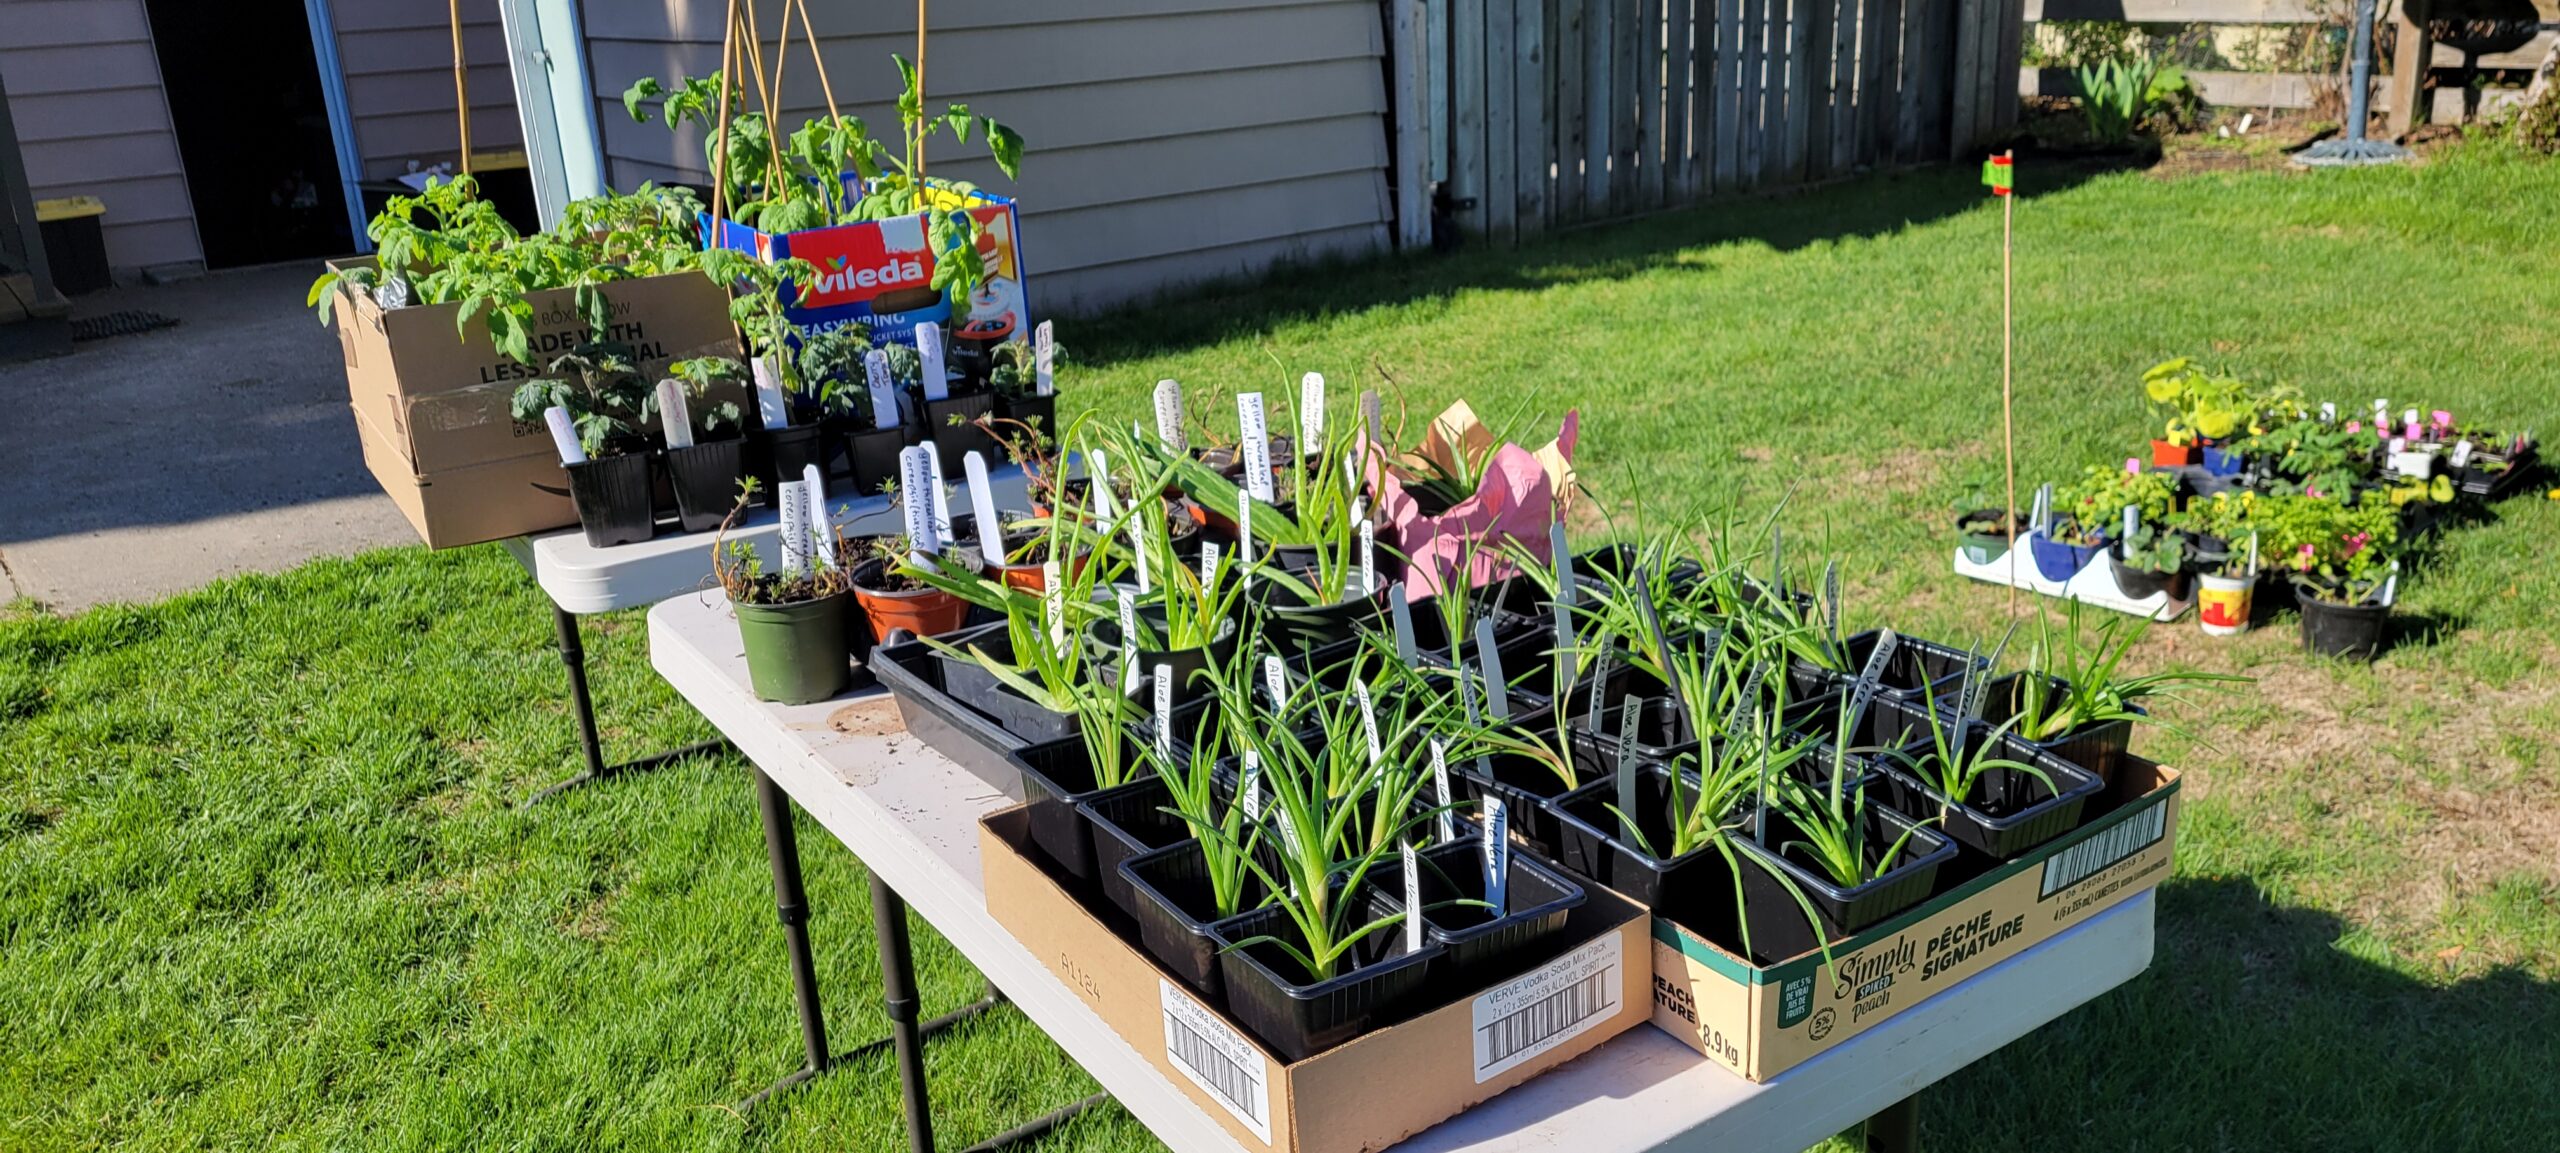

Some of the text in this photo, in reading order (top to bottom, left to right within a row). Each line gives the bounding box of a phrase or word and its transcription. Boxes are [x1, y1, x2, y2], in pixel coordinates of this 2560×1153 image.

[814, 258, 924, 294] vileda
[541, 310, 572, 326] BOX
[512, 331, 574, 354] ADE
[480, 361, 541, 384] LESS
[1248, 397, 1262, 430] yellow
[797, 485, 808, 518] yellow
[919, 452, 936, 534] yellow threadleaf
[1205, 547, 1216, 573] Aloe
[1158, 674, 1167, 703] Aloe
[1269, 663, 1280, 692] Aloe
[1594, 642, 1612, 711] Aloe Vera
[1855, 642, 1891, 705] Aloe Vera
[1463, 680, 1475, 710] Aloe
[1731, 670, 1764, 736] Aloe Vera
[1959, 687, 1973, 719] Vera
[1361, 691, 1376, 748] Aloe Vera
[1621, 703, 1638, 765] Aloe Vera
[1433, 750, 1443, 781] Aloe
[1245, 794, 1256, 816] Ver
[1488, 806, 1504, 870] Aloe Vera
[1405, 848, 1416, 913] Aloe Vera
[1921, 914, 2025, 981] SIGNATURE
[1925, 909, 1992, 959] PÊCHE
[1061, 952, 1101, 1002] A1124
[1489, 939, 1608, 1005] VERVE Vodka Soda Mix Pack
[1834, 934, 1916, 999] Simply
[1492, 1008, 1497, 1020] 2
[1504, 1003, 1511, 1015] 12
[1536, 985, 1550, 1001] 5.5%
[1581, 958, 1601, 977] SPIRIT
[1785, 980, 1800, 993] AVEC
[1786, 986, 1809, 1001] DE VRAI
[1787, 995, 1806, 1010] JUS DE
[1859, 976, 1890, 999] SPIKED
[1167, 985, 1253, 1058] VERVE Vodka Soda Mix Pack
[1653, 988, 1695, 1024] ATURE
[1786, 1005, 1805, 1020] FRUITS
[1815, 1014, 1830, 1029] 5%
[1521, 1050, 1530, 1058] 01
[1703, 1024, 1738, 1067] 8.9 kg
